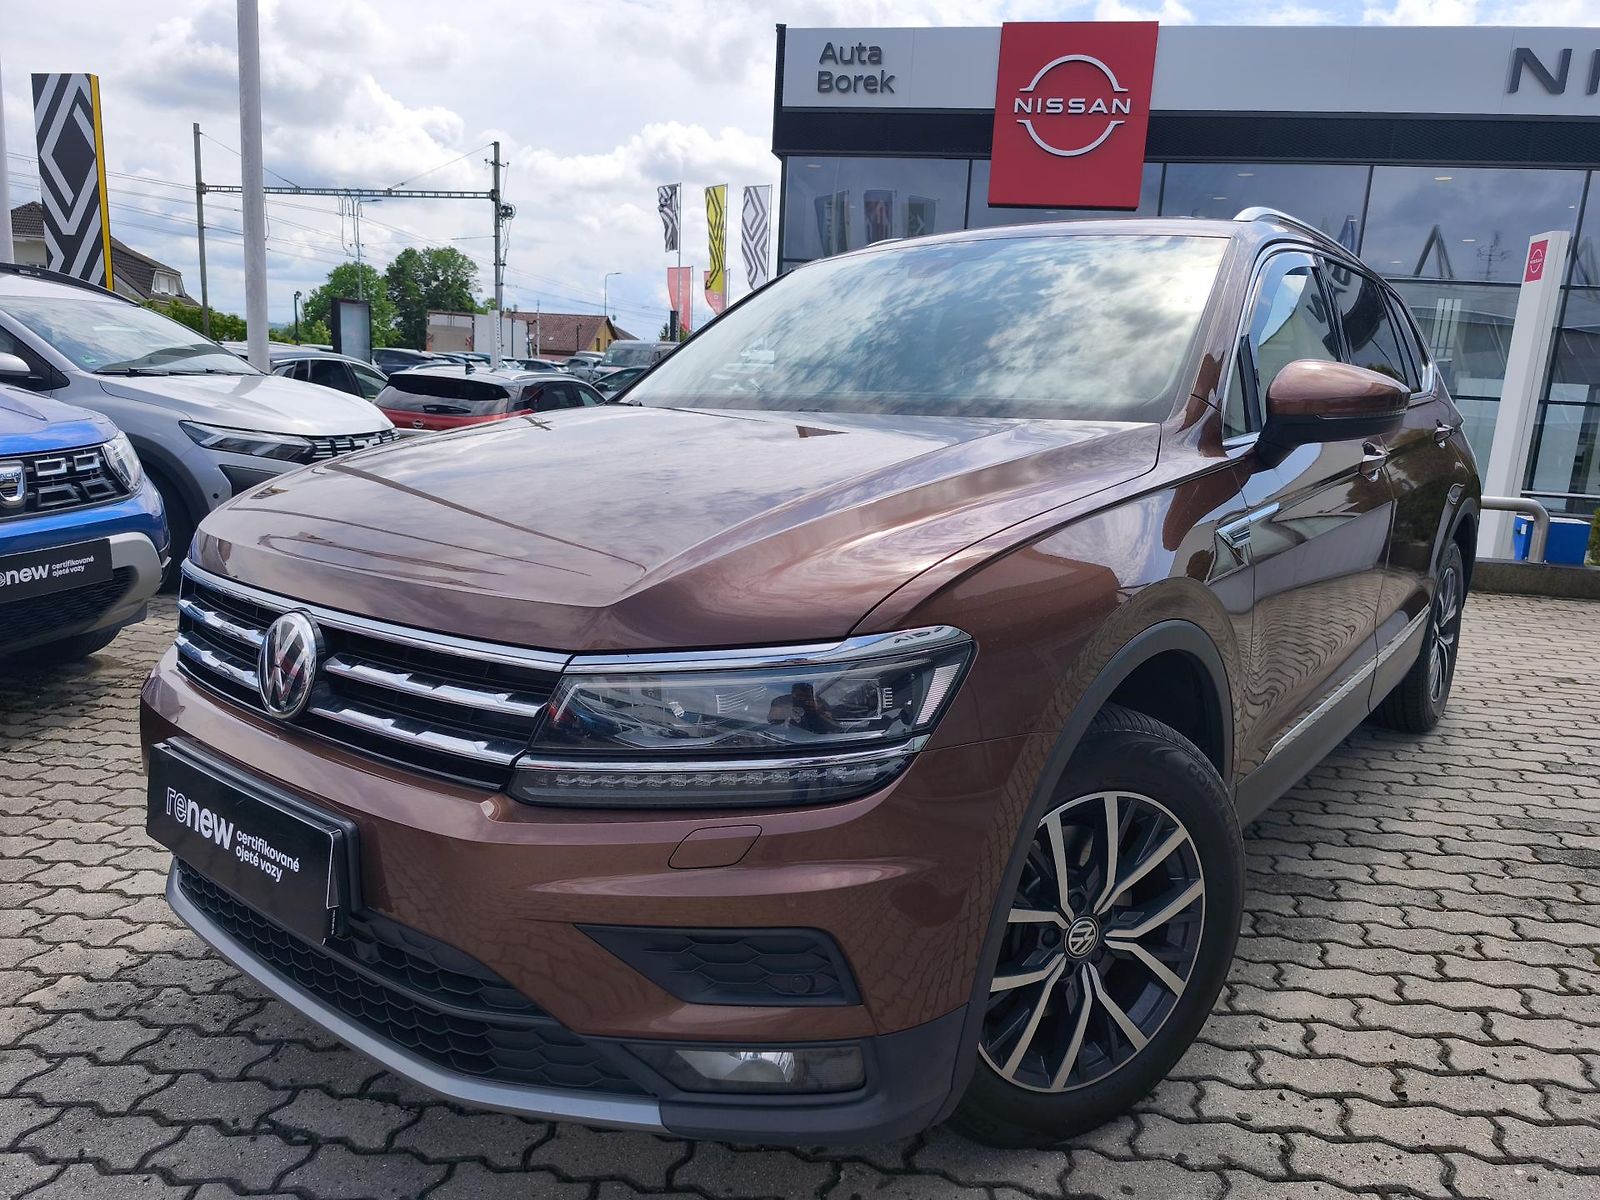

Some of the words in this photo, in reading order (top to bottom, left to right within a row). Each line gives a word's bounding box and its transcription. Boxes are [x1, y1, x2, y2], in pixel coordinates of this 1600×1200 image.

[819, 42, 882, 65] Auta
[817, 69, 895, 94] Borek
[1014, 98, 1131, 114] NISSAN
[166, 786, 234, 850] renew
[235, 845, 259, 867] ojeté
[260, 858, 283, 882] vozy
[236, 830, 300, 873] certifikované
